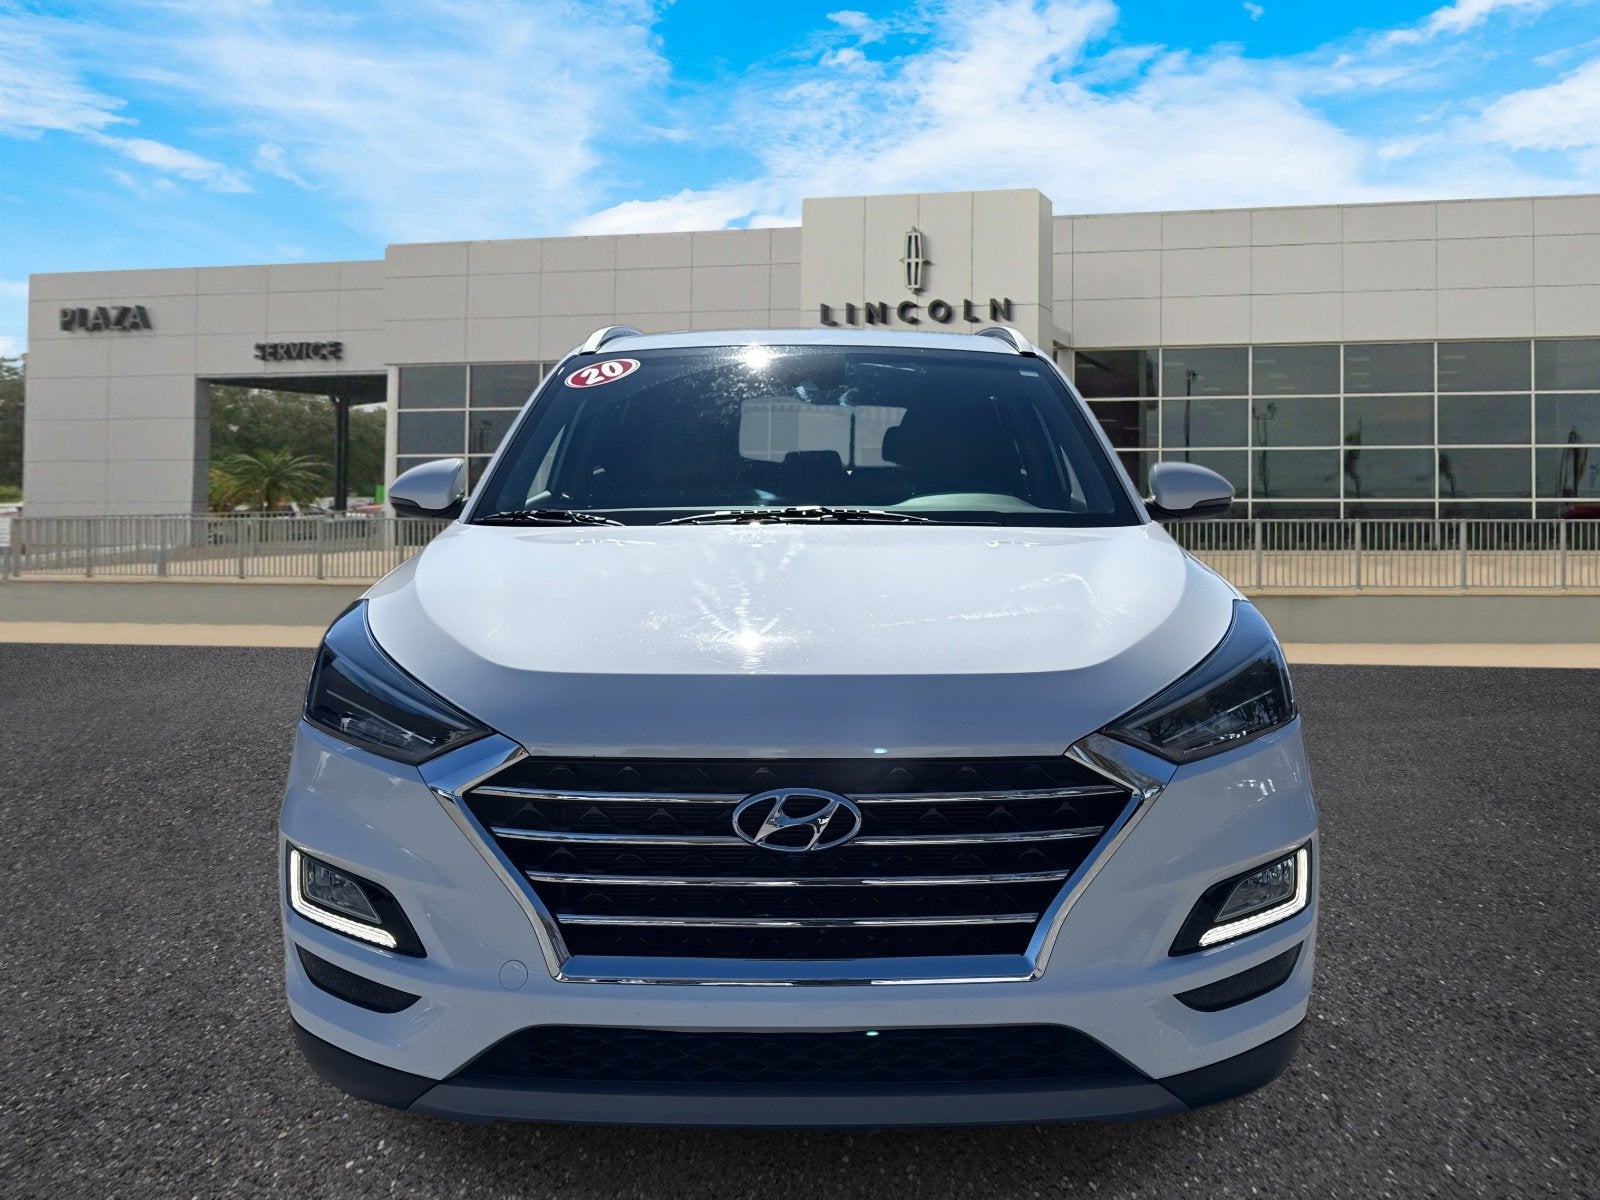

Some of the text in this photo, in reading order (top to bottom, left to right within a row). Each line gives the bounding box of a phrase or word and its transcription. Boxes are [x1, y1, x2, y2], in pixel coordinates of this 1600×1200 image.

[60, 306, 153, 331] PLAZA
[820, 298, 1012, 326] LINCOLN
[254, 341, 344, 361] SERVICE
[580, 361, 624, 385] 20
